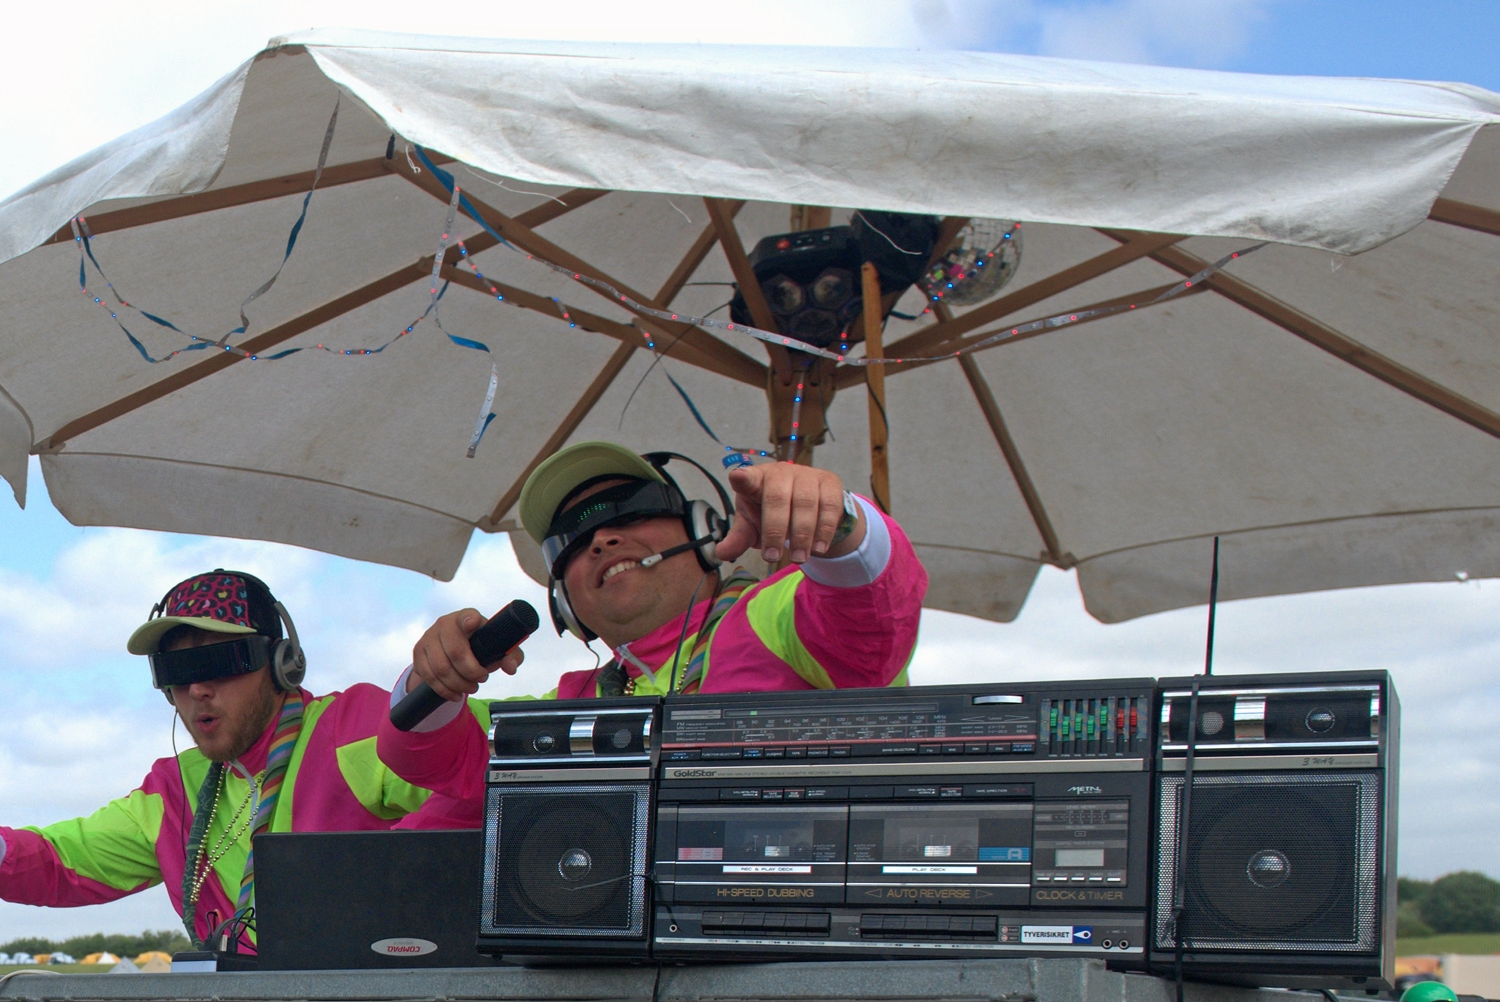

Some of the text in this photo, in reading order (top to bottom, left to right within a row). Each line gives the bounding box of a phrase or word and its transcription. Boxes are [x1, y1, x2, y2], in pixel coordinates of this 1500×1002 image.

[1302, 758, 1310, 766] 3
[1312, 756, 1335, 766] WAY
[494, 772, 500, 780] 3
[502, 772, 518, 780] WAY
[674, 770, 717, 778] GoldStar
[1008, 848, 1022, 860] A
[717, 888, 814, 898] HI-SPEED DUBBING
[887, 889, 970, 898] AUTO REVERSE
[1036, 890, 1123, 900] CLOCK & TIMER
